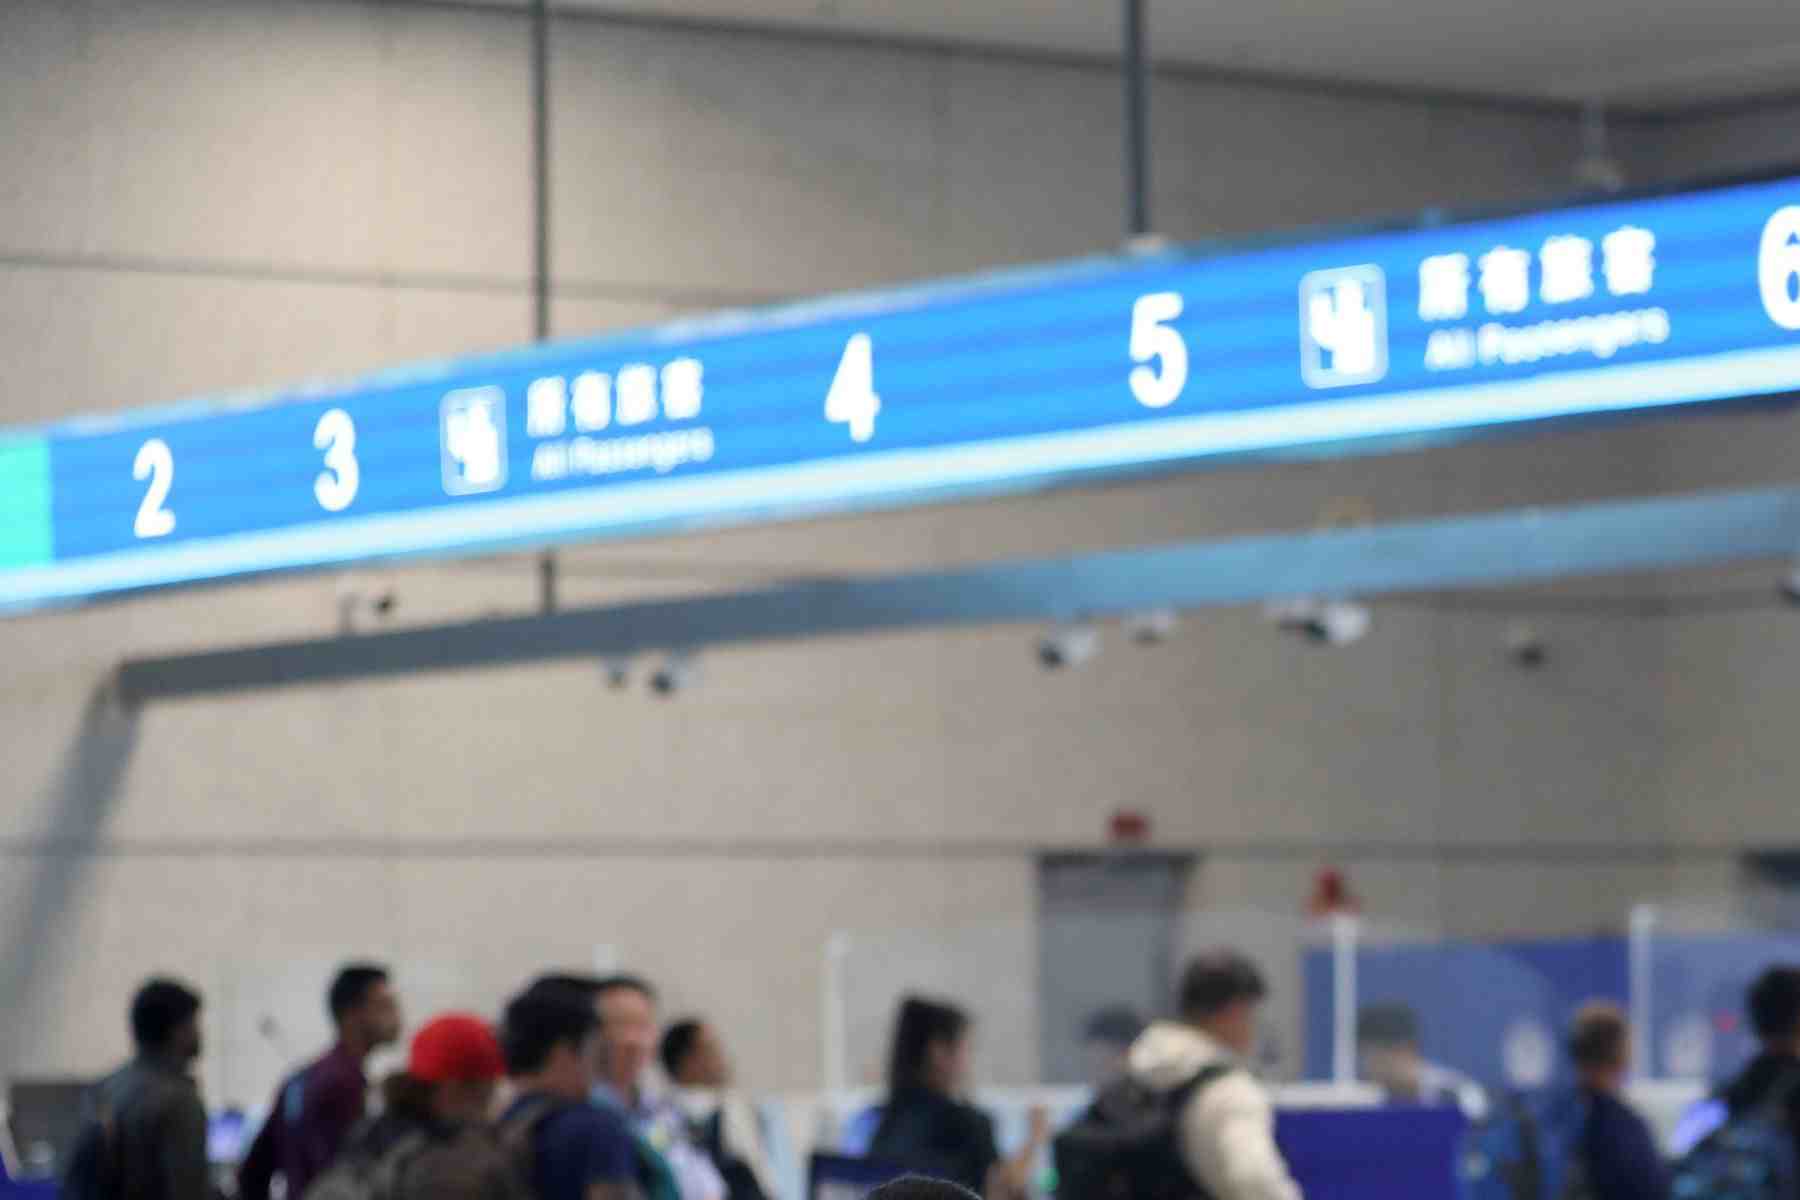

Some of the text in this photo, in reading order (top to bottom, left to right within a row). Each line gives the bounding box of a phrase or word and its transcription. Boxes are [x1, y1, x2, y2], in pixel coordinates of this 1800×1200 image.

[825, 333, 880, 441] 4
[1129, 292, 1188, 408] 5
[133, 438, 176, 538] 2
[312, 408, 359, 511] 3
